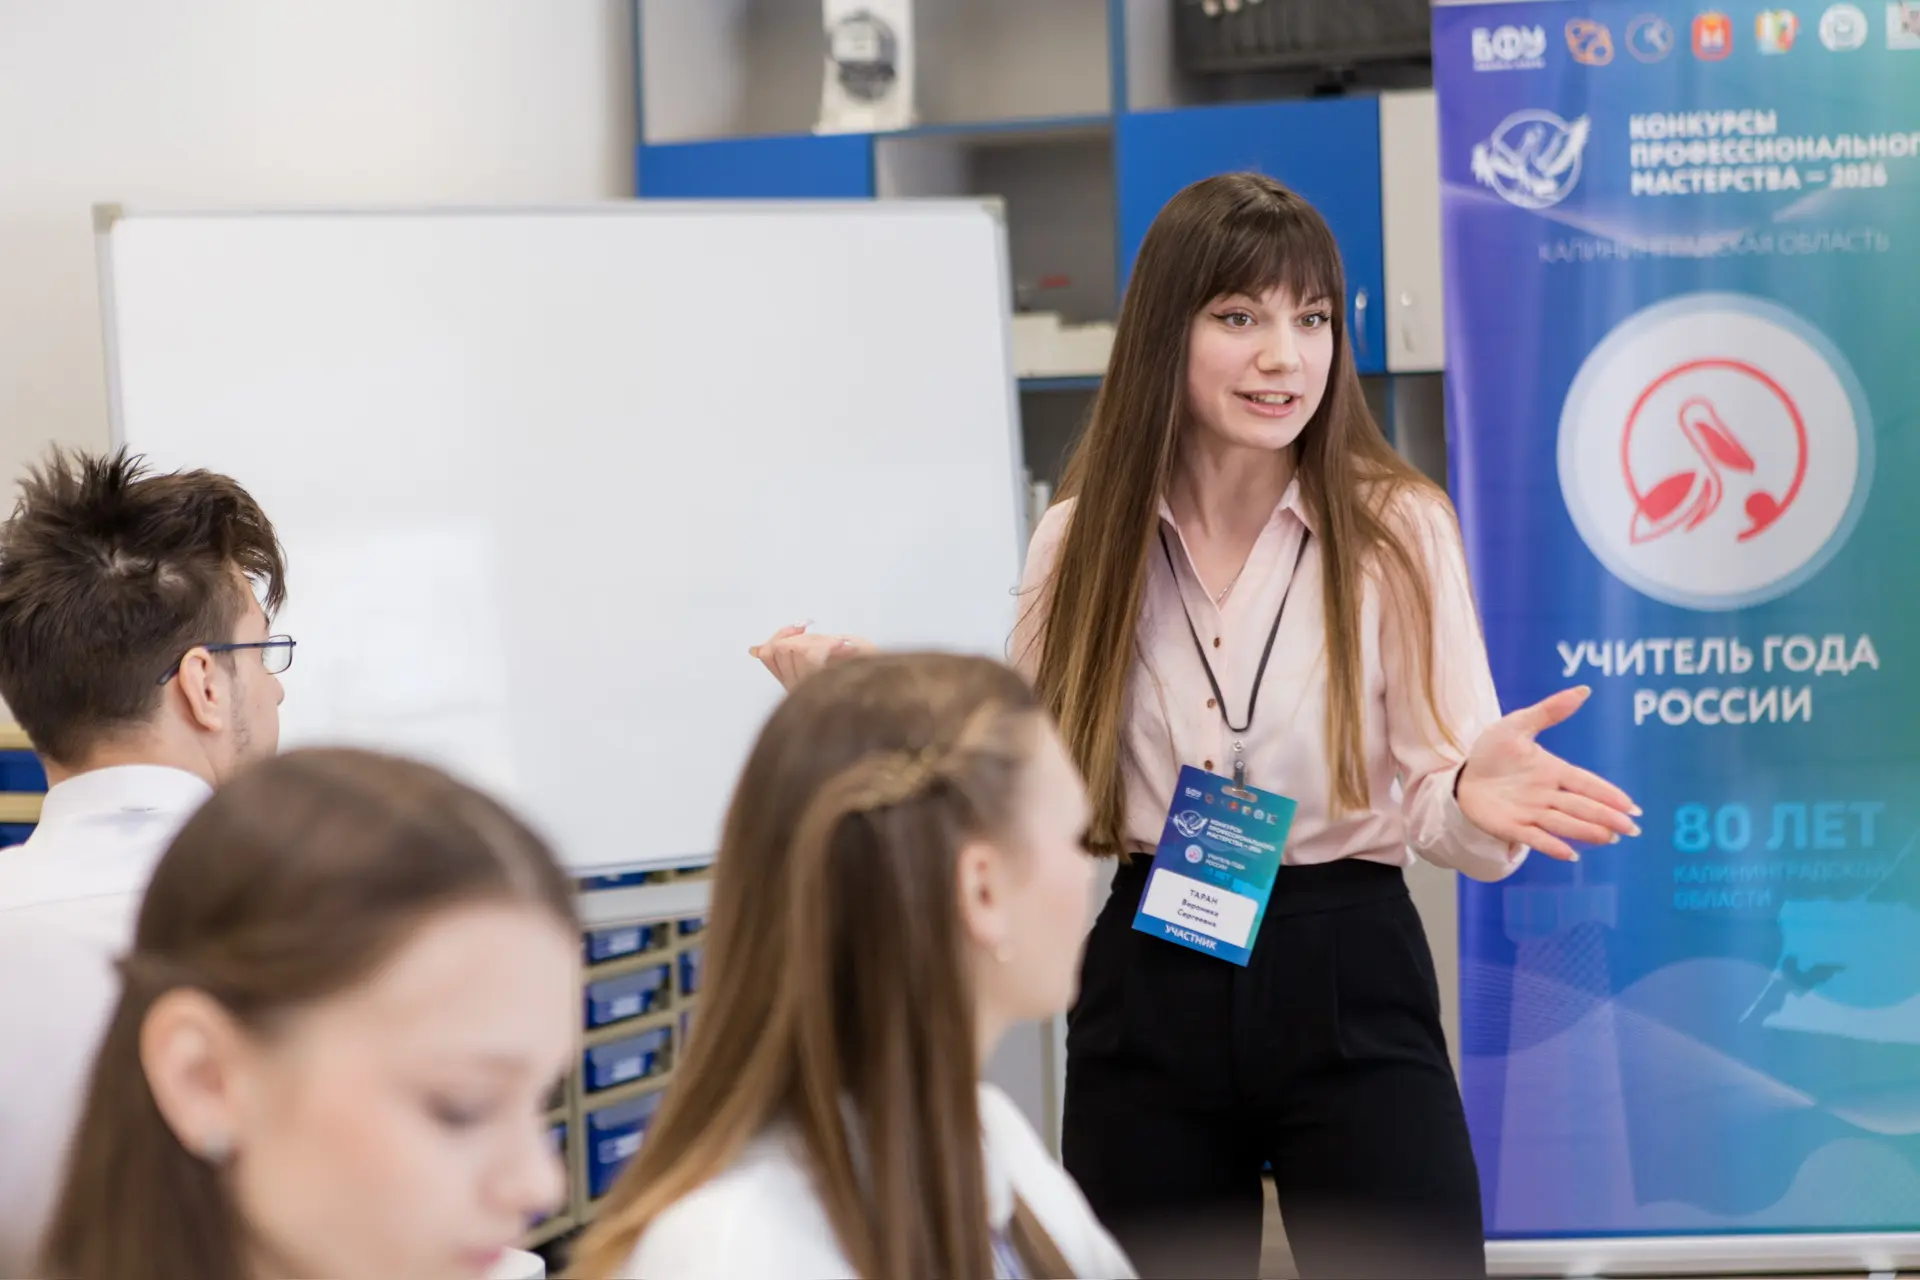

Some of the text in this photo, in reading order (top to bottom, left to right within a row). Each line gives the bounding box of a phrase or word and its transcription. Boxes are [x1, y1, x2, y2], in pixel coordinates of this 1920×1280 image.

[1472, 24, 1547, 61] БФУ
[1629, 109, 1777, 139] КОНКУРСЫ
[1631, 164, 1801, 196] МАСТЕРСТВА
[1830, 162, 1888, 189] 2026
[1778, 227, 1891, 256] ОБЛАСТЬ
[1557, 633, 1879, 677] УЧИТЕЛЬ ГОДА
[1634, 685, 1812, 726] РОССИИ
[1673, 801, 1885, 853] 80 ЛЕТ
[1181, 899, 1219, 917] Вероника
[1189, 889, 1219, 905] ТАРАН
[1674, 888, 1772, 910] ОБЛАСТИ
[1177, 909, 1217, 928] Сергеевна
[1165, 924, 1218, 950] УЧАСТНИК
